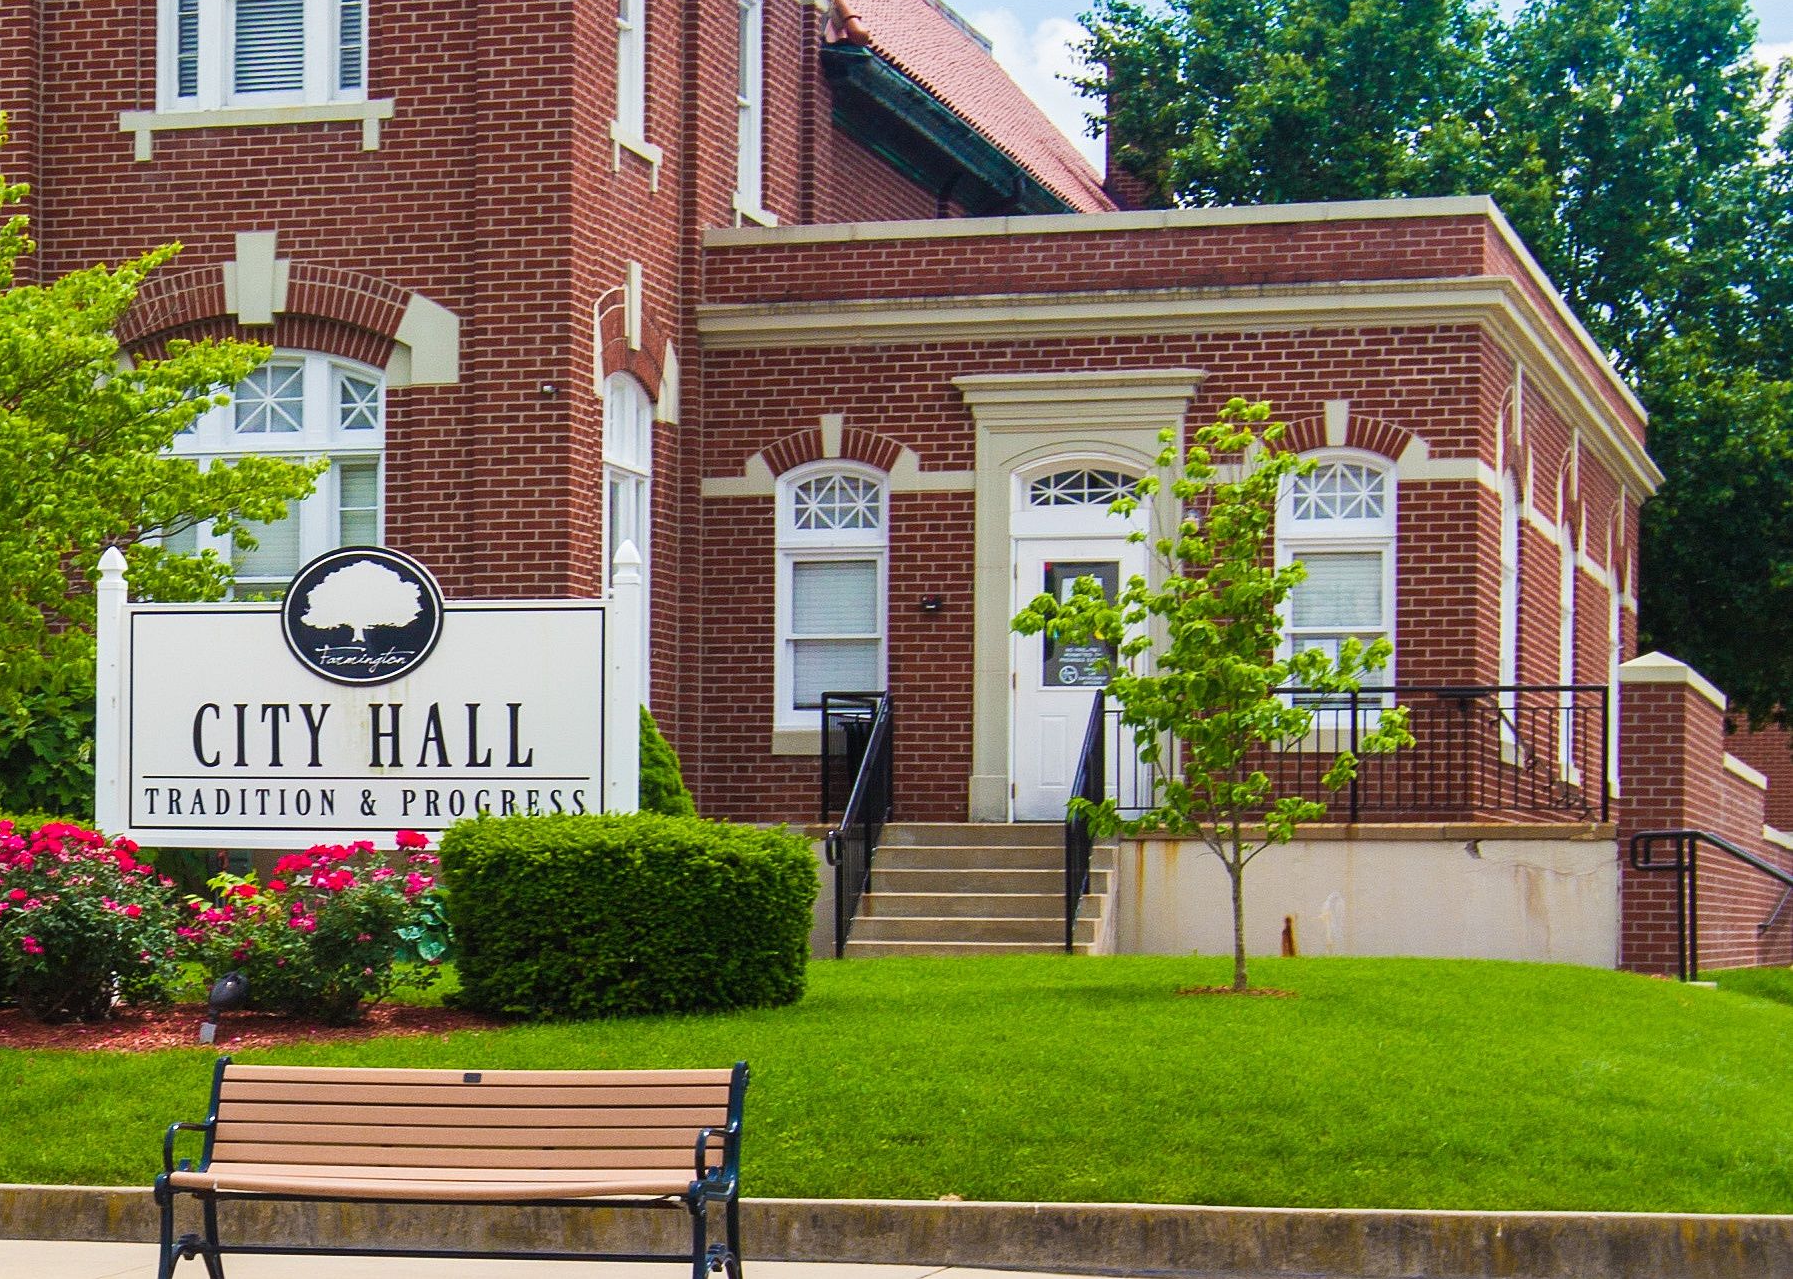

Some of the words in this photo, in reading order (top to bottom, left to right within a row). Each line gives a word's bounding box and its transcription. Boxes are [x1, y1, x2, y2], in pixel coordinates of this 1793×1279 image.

[314, 644, 416, 674] Farmington
[192, 702, 332, 768] CITY
[367, 702, 534, 768] HALL
[144, 787, 336, 816] TRADITION
[360, 788, 377, 817] &
[401, 788, 586, 817] PROGRESS
